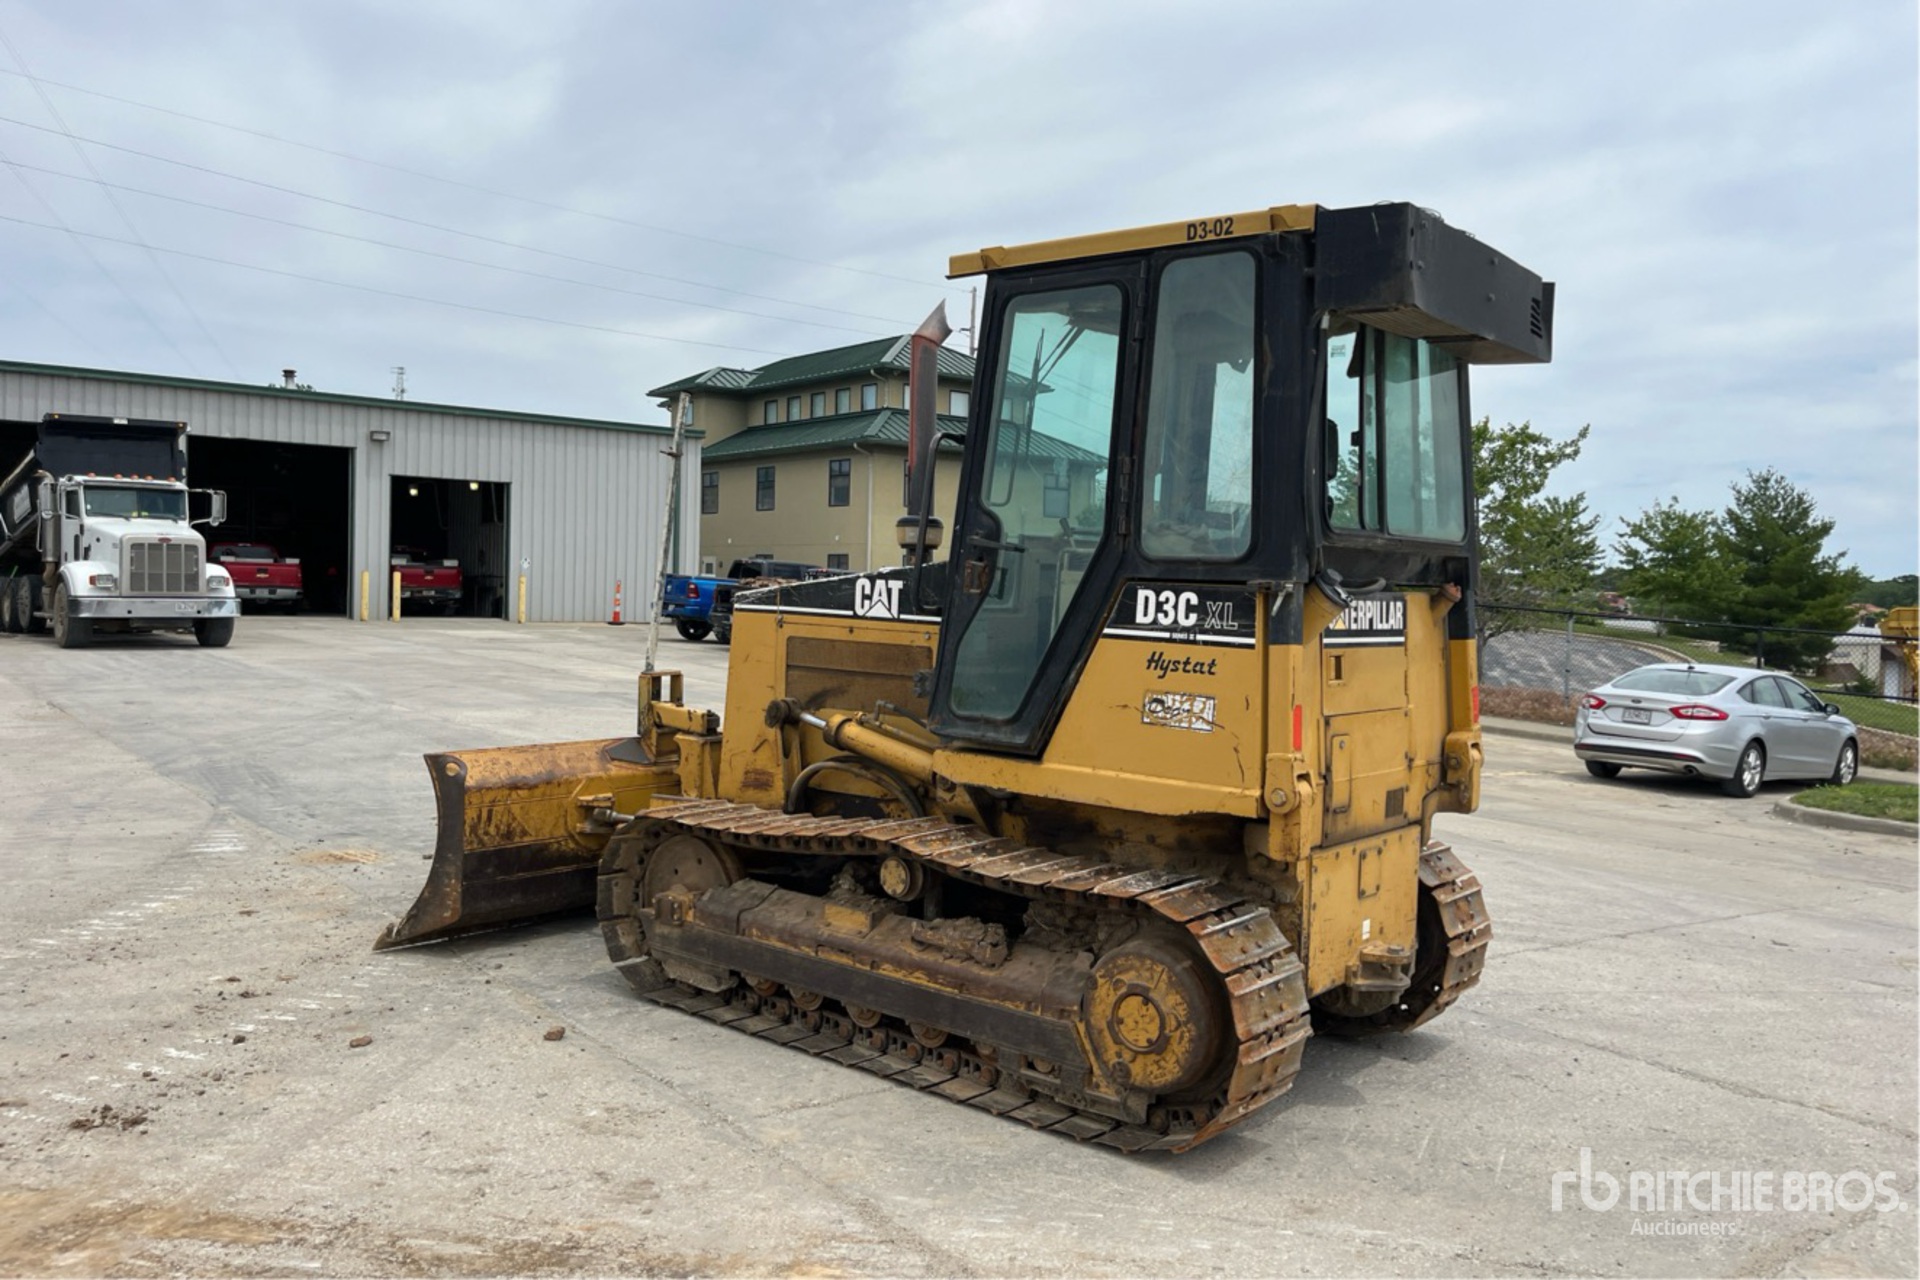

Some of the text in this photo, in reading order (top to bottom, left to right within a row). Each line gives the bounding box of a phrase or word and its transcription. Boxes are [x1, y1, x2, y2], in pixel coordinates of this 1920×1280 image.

[1186, 216, 1234, 241] D3-02
[854, 577, 904, 619] CAT
[1135, 588, 1239, 630] D3C XL
[1146, 651, 1217, 679] Hystat
